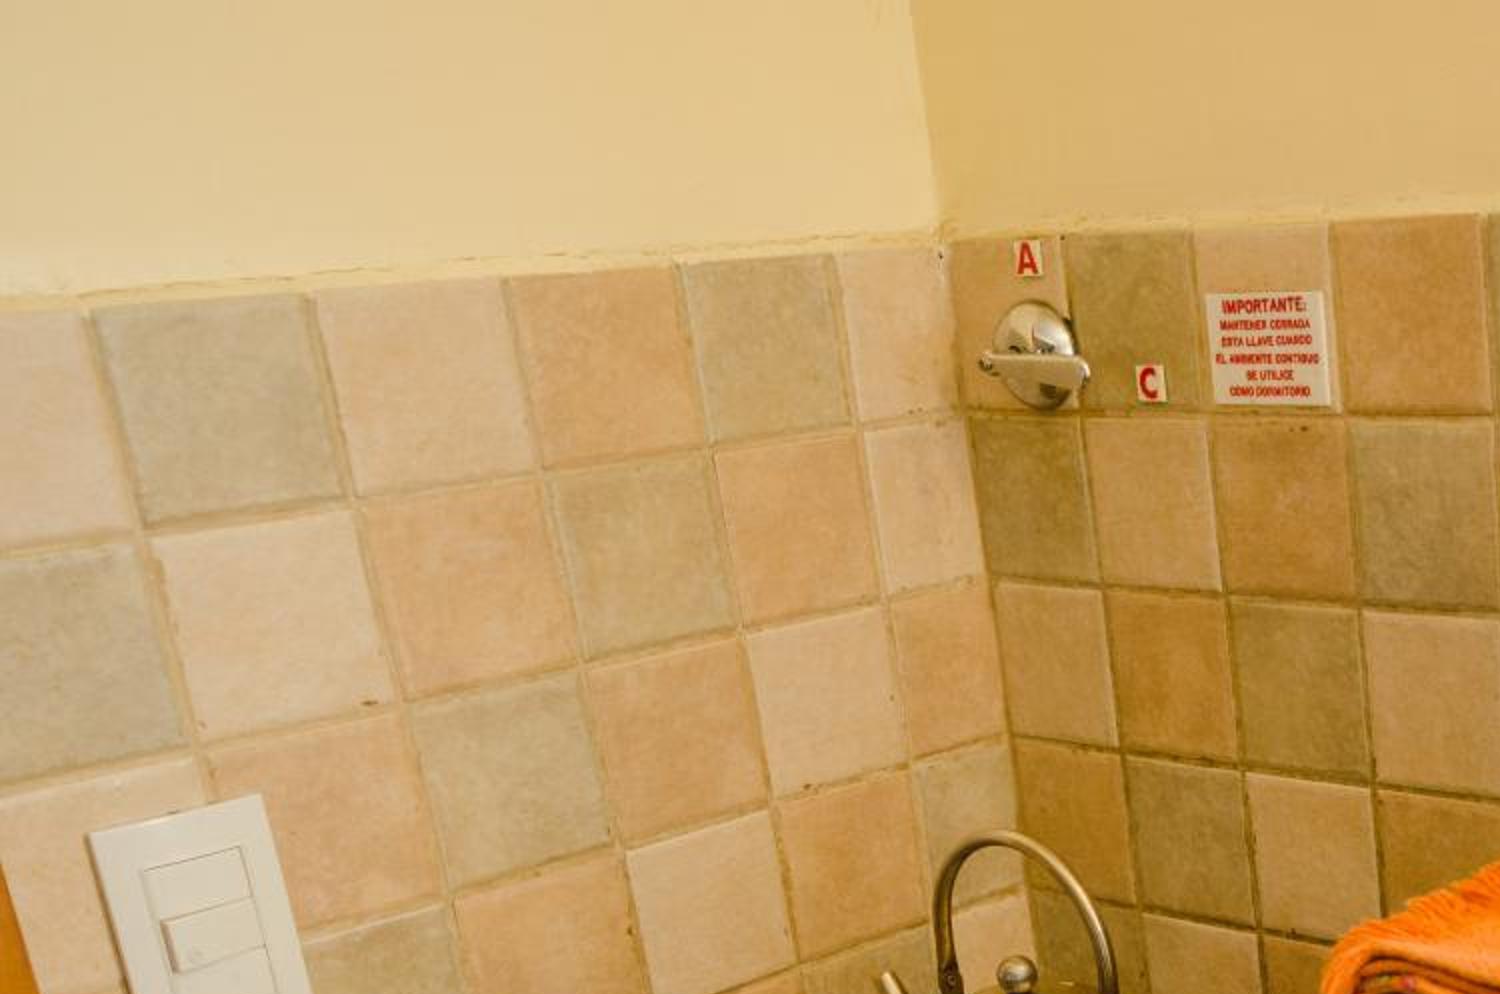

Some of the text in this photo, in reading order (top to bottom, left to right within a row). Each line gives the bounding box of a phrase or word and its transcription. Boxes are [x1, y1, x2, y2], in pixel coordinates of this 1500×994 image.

[1017, 242, 1039, 275] A
[1221, 296, 1307, 314] IMPORTANTE:
[1139, 367, 1159, 399] C
